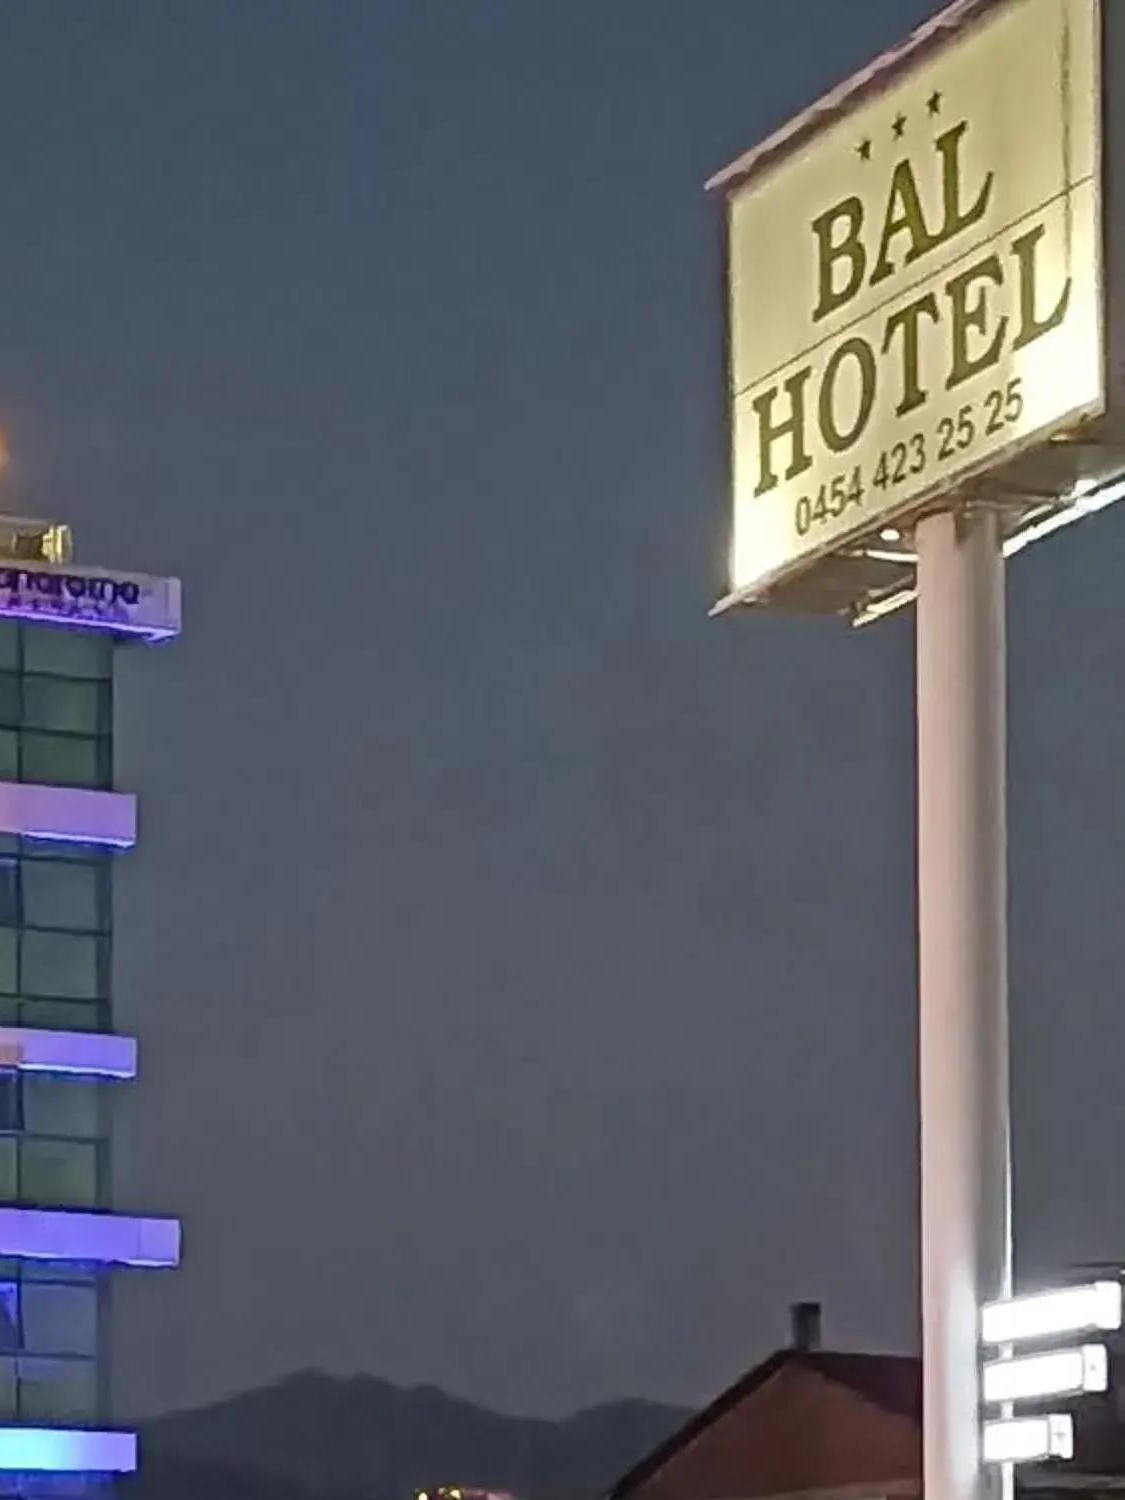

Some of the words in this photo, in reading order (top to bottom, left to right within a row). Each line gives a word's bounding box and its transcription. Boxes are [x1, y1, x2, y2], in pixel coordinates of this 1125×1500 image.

[810, 119, 995, 324] BAL
[752, 223, 1072, 499] HOTEL
[795, 470, 866, 536] 0454
[873, 433, 927, 491] 423
[937, 415, 975, 464] 25
[985, 376, 1024, 436] 25
